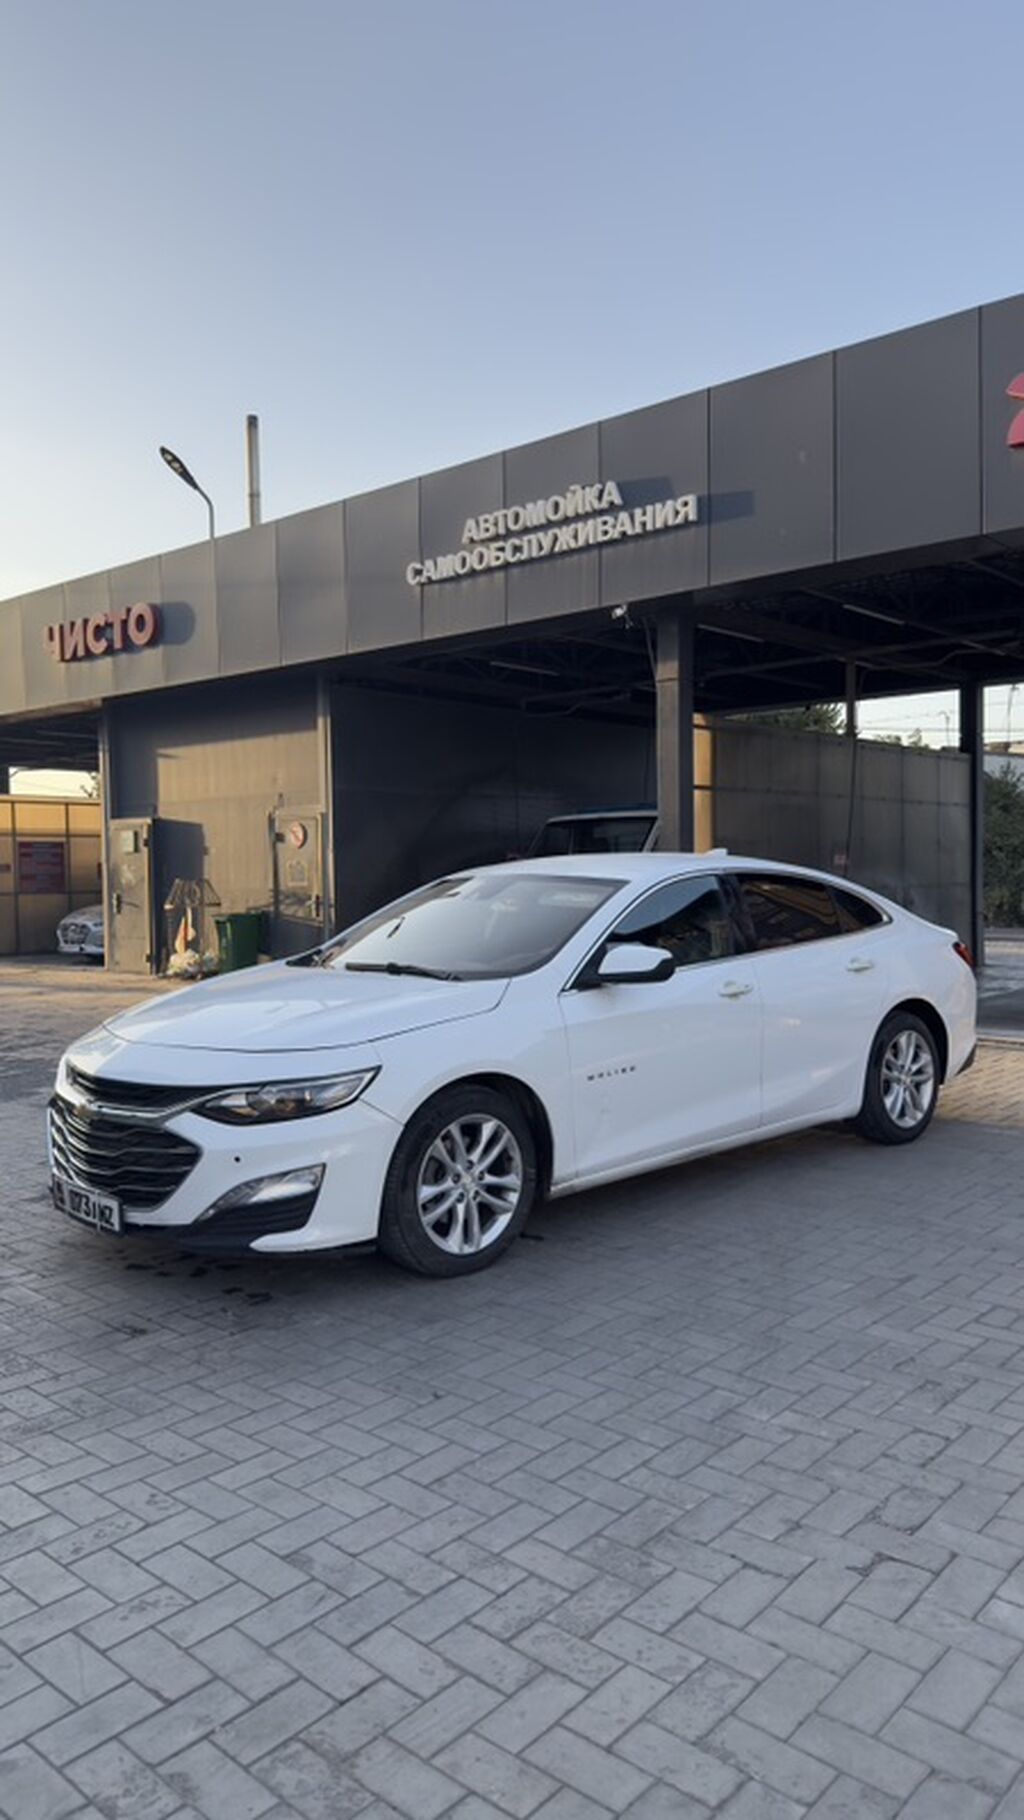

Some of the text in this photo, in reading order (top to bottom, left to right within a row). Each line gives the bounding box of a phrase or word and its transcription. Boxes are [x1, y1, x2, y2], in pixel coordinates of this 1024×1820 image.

[406, 495, 698, 584] САМООБСЛУЖИВАНИЯ
[462, 481, 622, 543] АВТОМОЙКА
[43, 602, 156, 661] ЧИСТО
